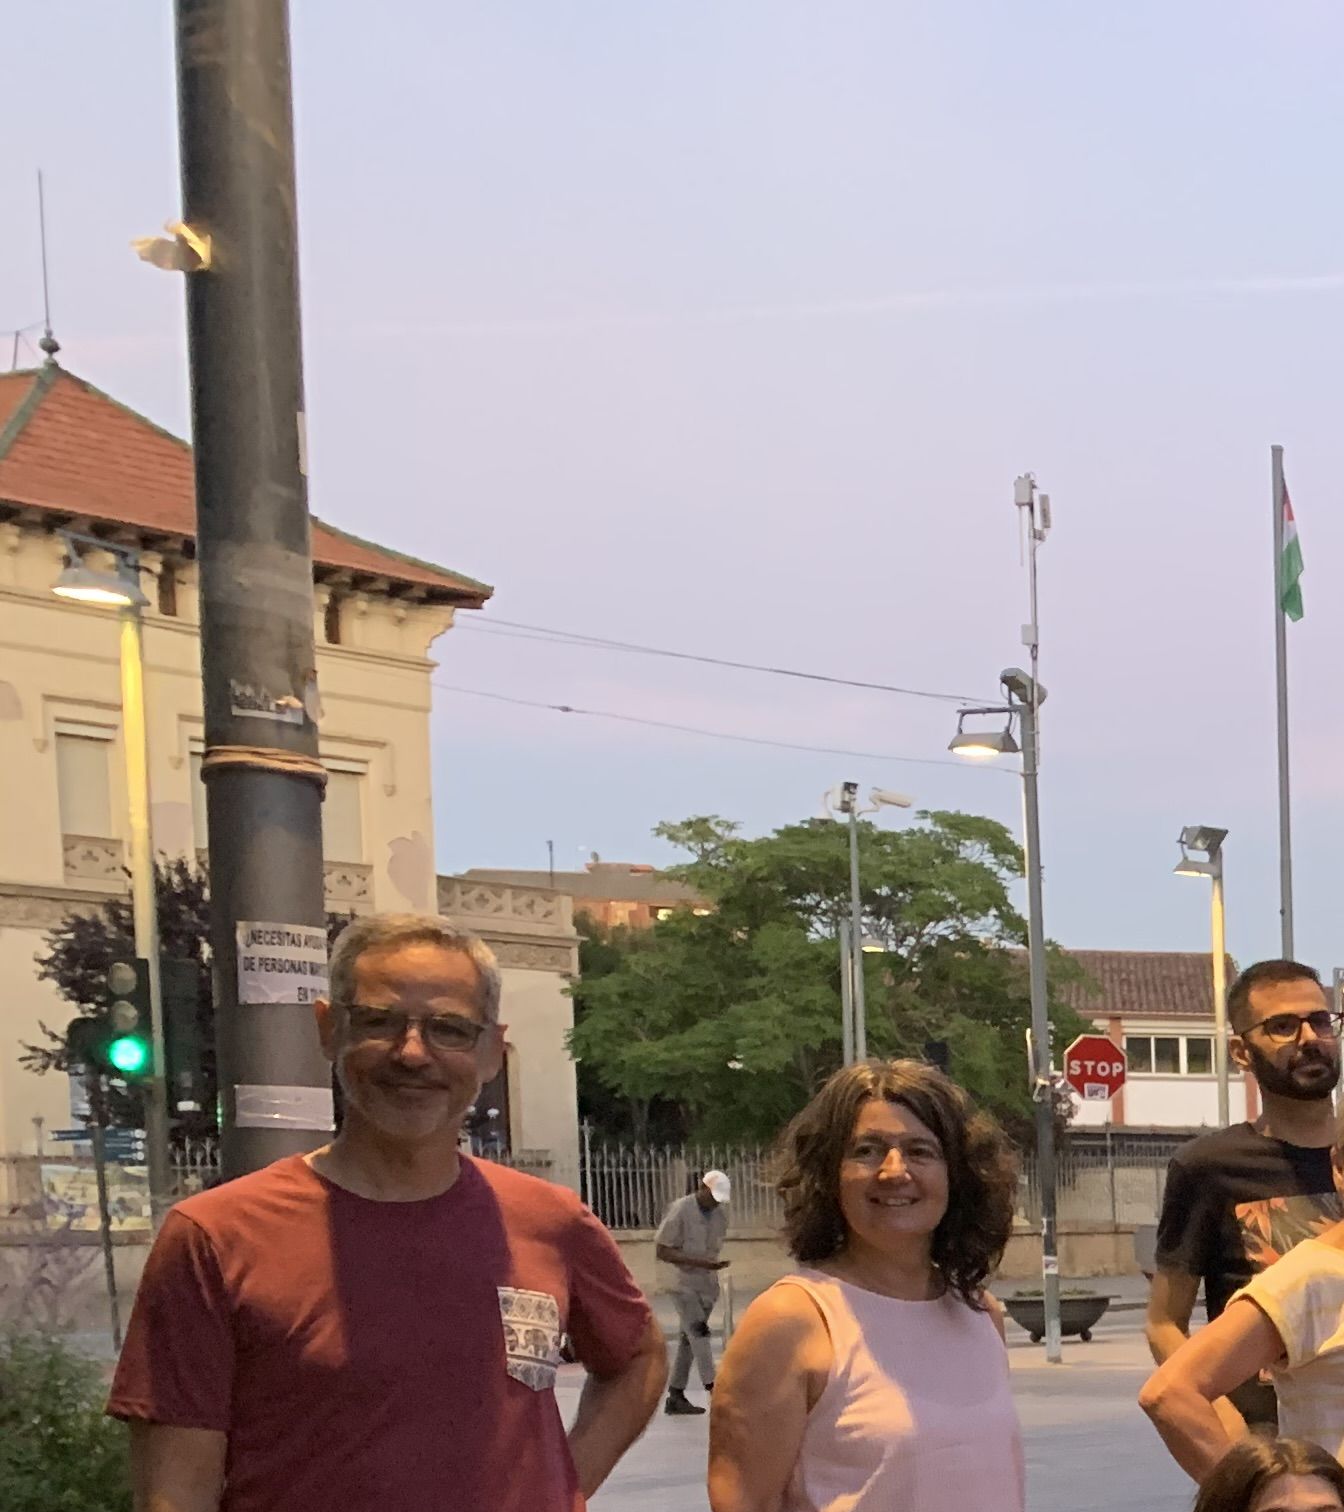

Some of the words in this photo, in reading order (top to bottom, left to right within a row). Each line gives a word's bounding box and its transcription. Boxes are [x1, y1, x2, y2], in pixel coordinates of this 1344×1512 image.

[245, 929, 302, 948] ¿NECESITAS
[243, 956, 256, 972] DE
[258, 957, 308, 975] PERSONAS
[1069, 1060, 1124, 1077] STOP
